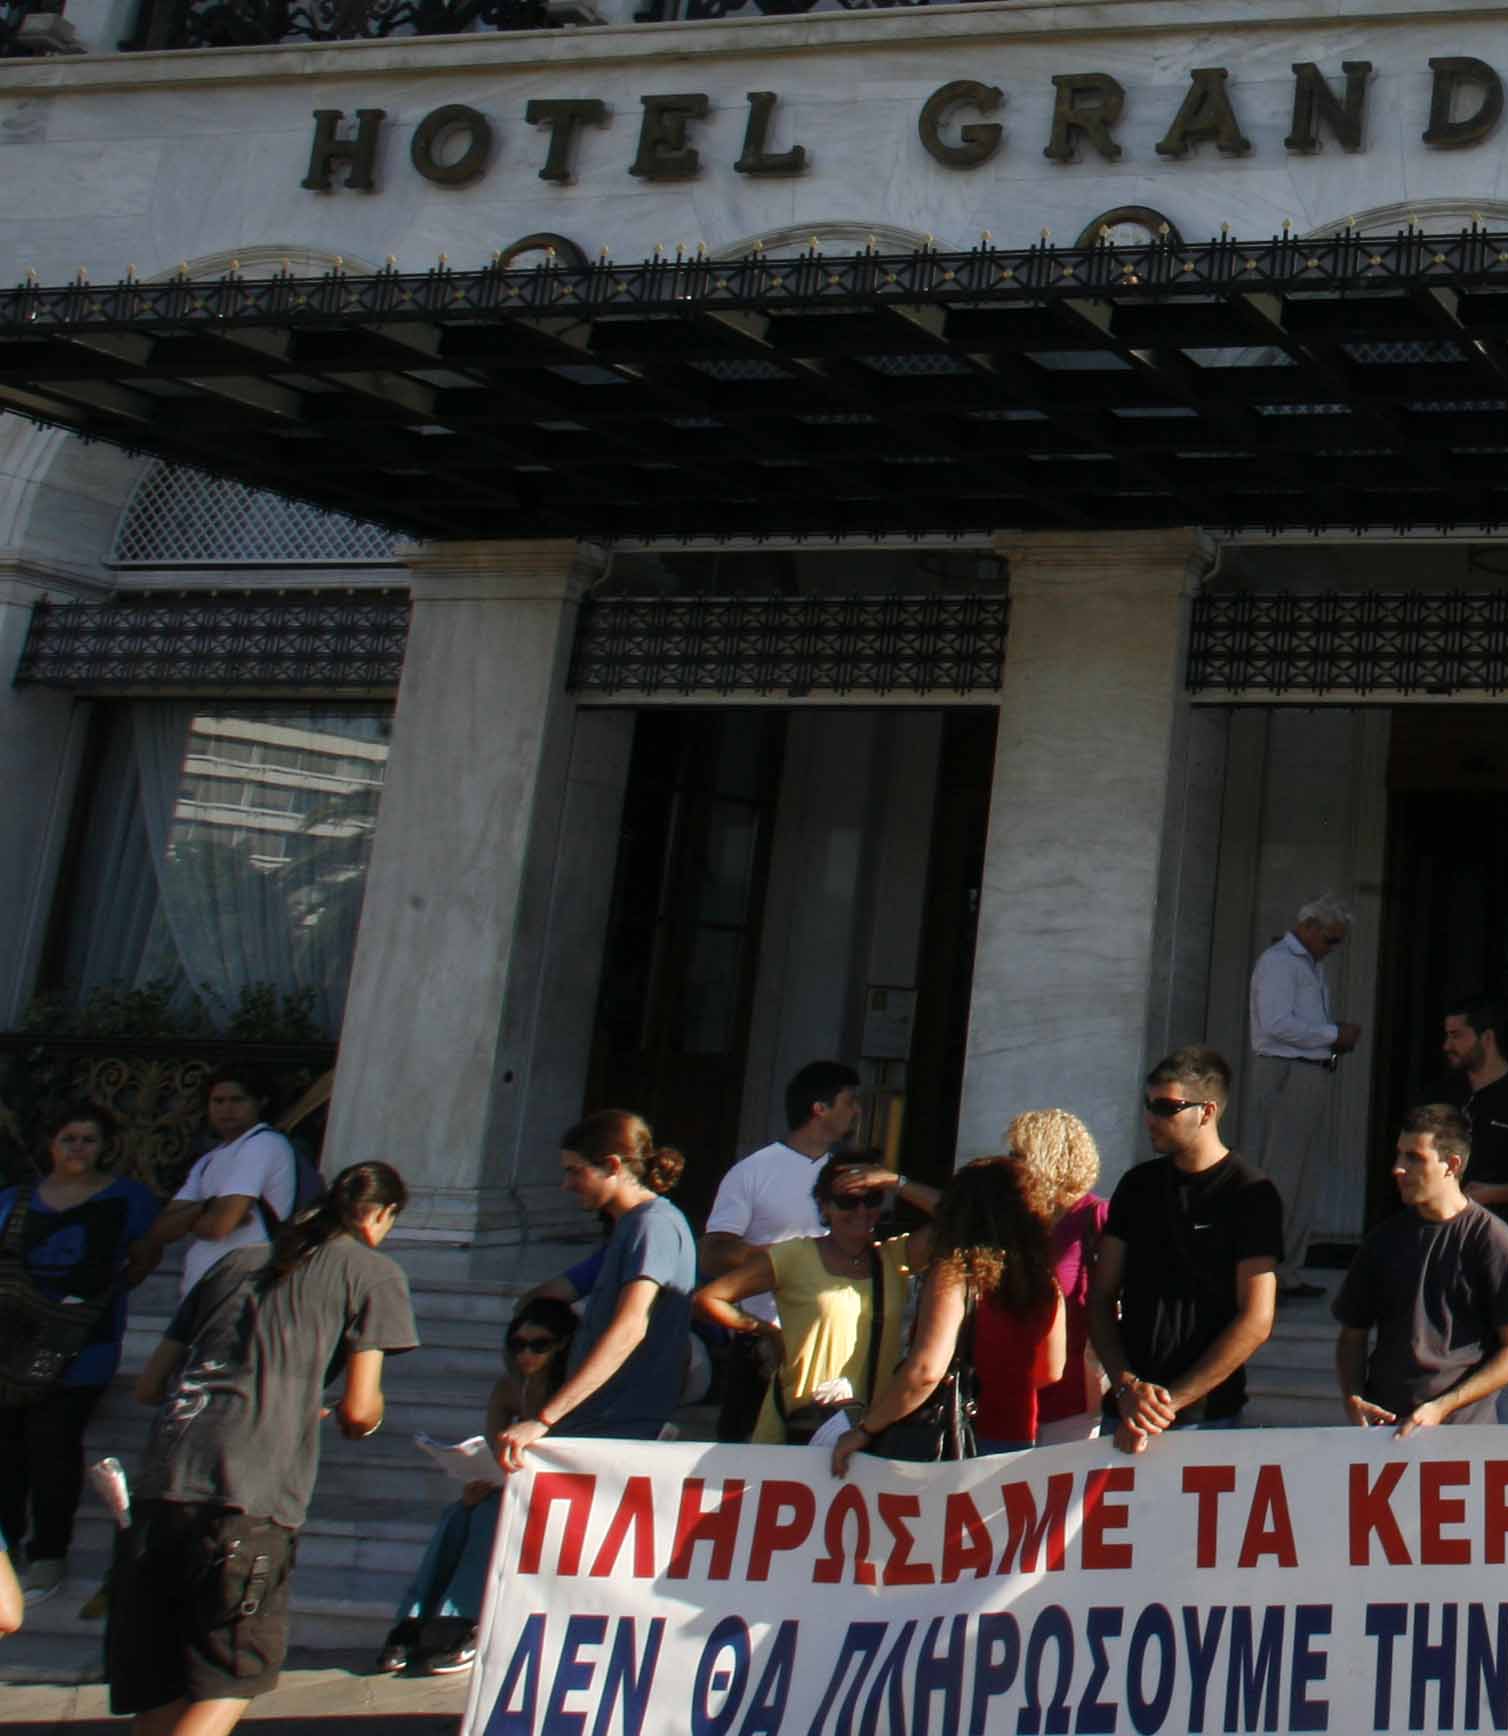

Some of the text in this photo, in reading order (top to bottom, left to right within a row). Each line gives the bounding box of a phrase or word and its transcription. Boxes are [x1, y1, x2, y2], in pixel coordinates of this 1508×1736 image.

[300, 90, 814, 194] HOTEL
[517, 1466, 1135, 1586] ΠΛΗΡΩΣΑΜΕ
[1182, 1465, 1297, 1568] ΤΑ
[482, 1614, 666, 1736] ΔΕΝ
[691, 1615, 799, 1736] ΘΑ
[805, 1602, 1333, 1736] ΠΛΗΡΩΣΟΥΜΕ
